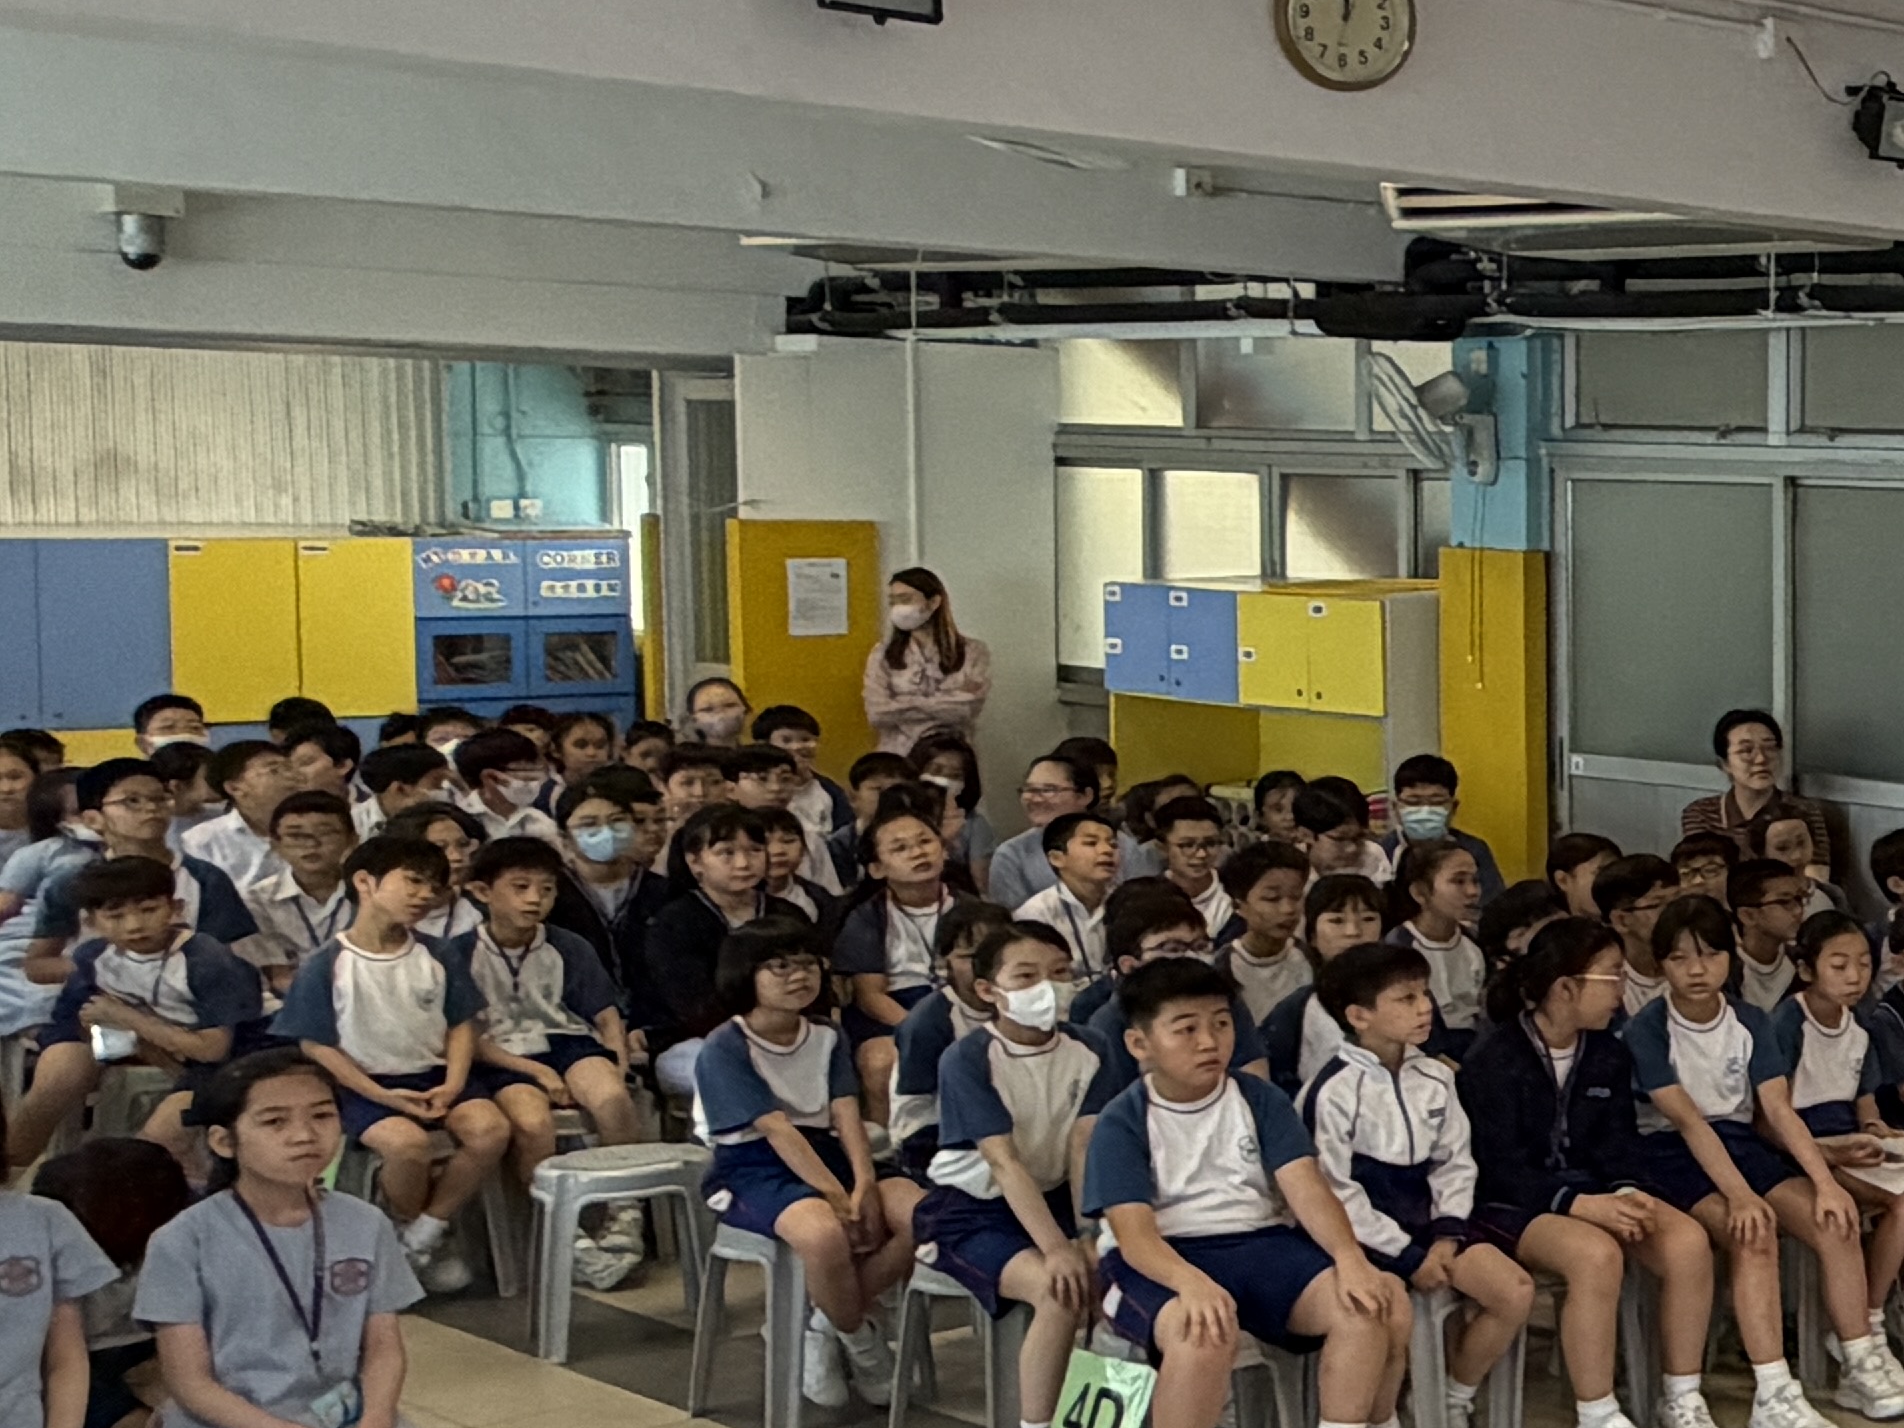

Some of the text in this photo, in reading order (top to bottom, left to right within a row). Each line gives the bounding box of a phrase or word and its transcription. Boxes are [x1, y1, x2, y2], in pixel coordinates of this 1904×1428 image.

[1299, 3, 1310, 18] 9
[1380, 16, 1390, 31] 3
[1304, 26, 1314, 42] 8
[1317, 44, 1329, 59] 7
[1373, 37, 1384, 51] 4
[1338, 52, 1348, 68] 6
[1358, 50, 1369, 65] 5
[539, 550, 619, 567] CORNER
